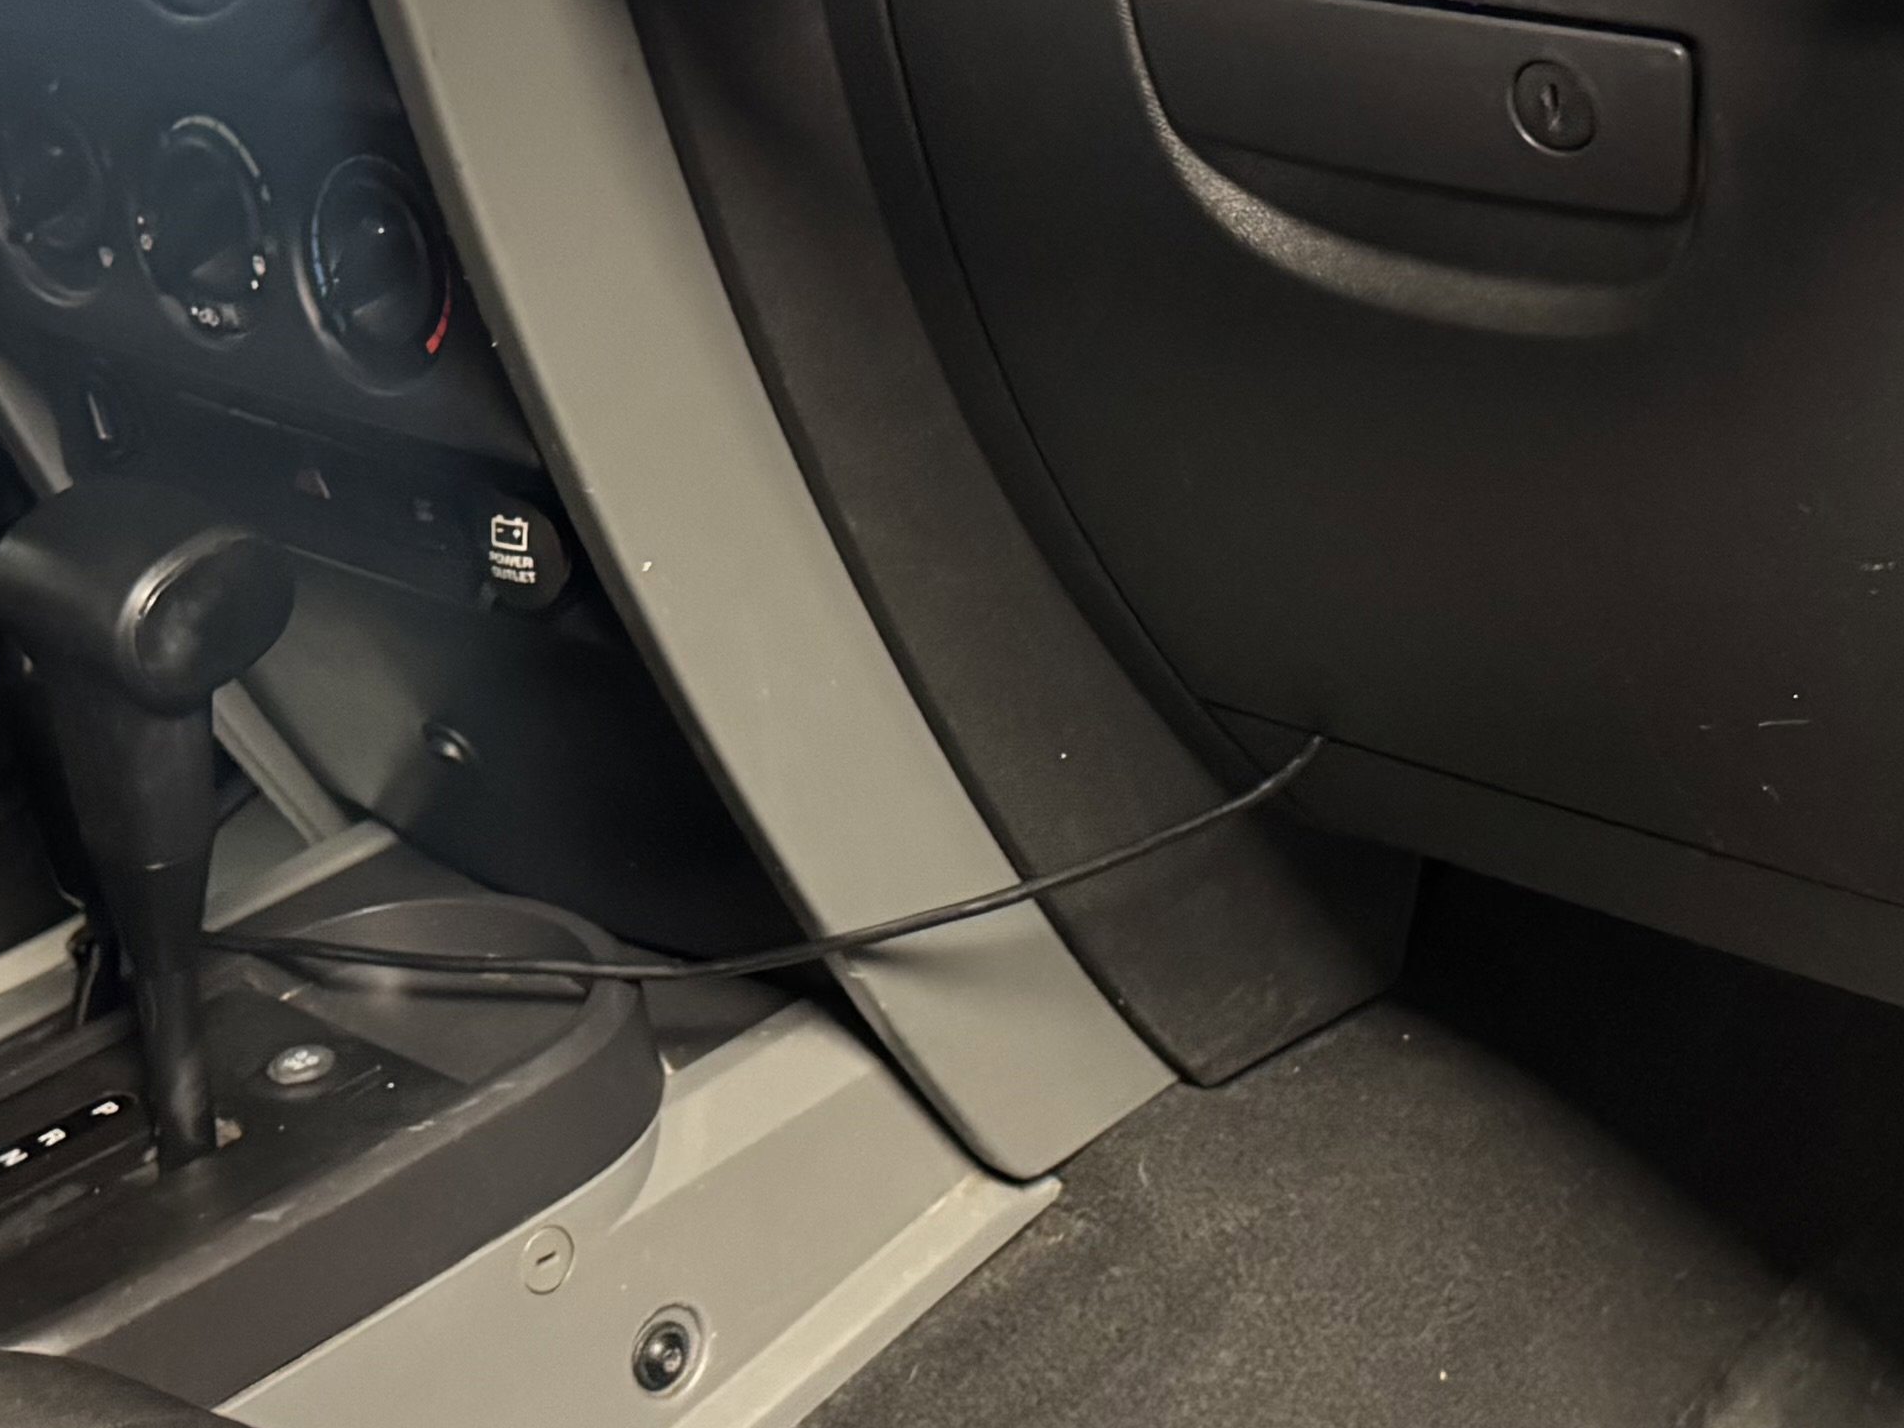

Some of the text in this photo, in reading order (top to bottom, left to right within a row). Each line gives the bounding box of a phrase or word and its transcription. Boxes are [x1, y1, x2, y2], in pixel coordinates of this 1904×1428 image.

[489, 551, 534, 568] POWER
[491, 566, 536, 583] OUTLET
[91, 1101, 119, 1116] P
[37, 1128, 66, 1147] R
